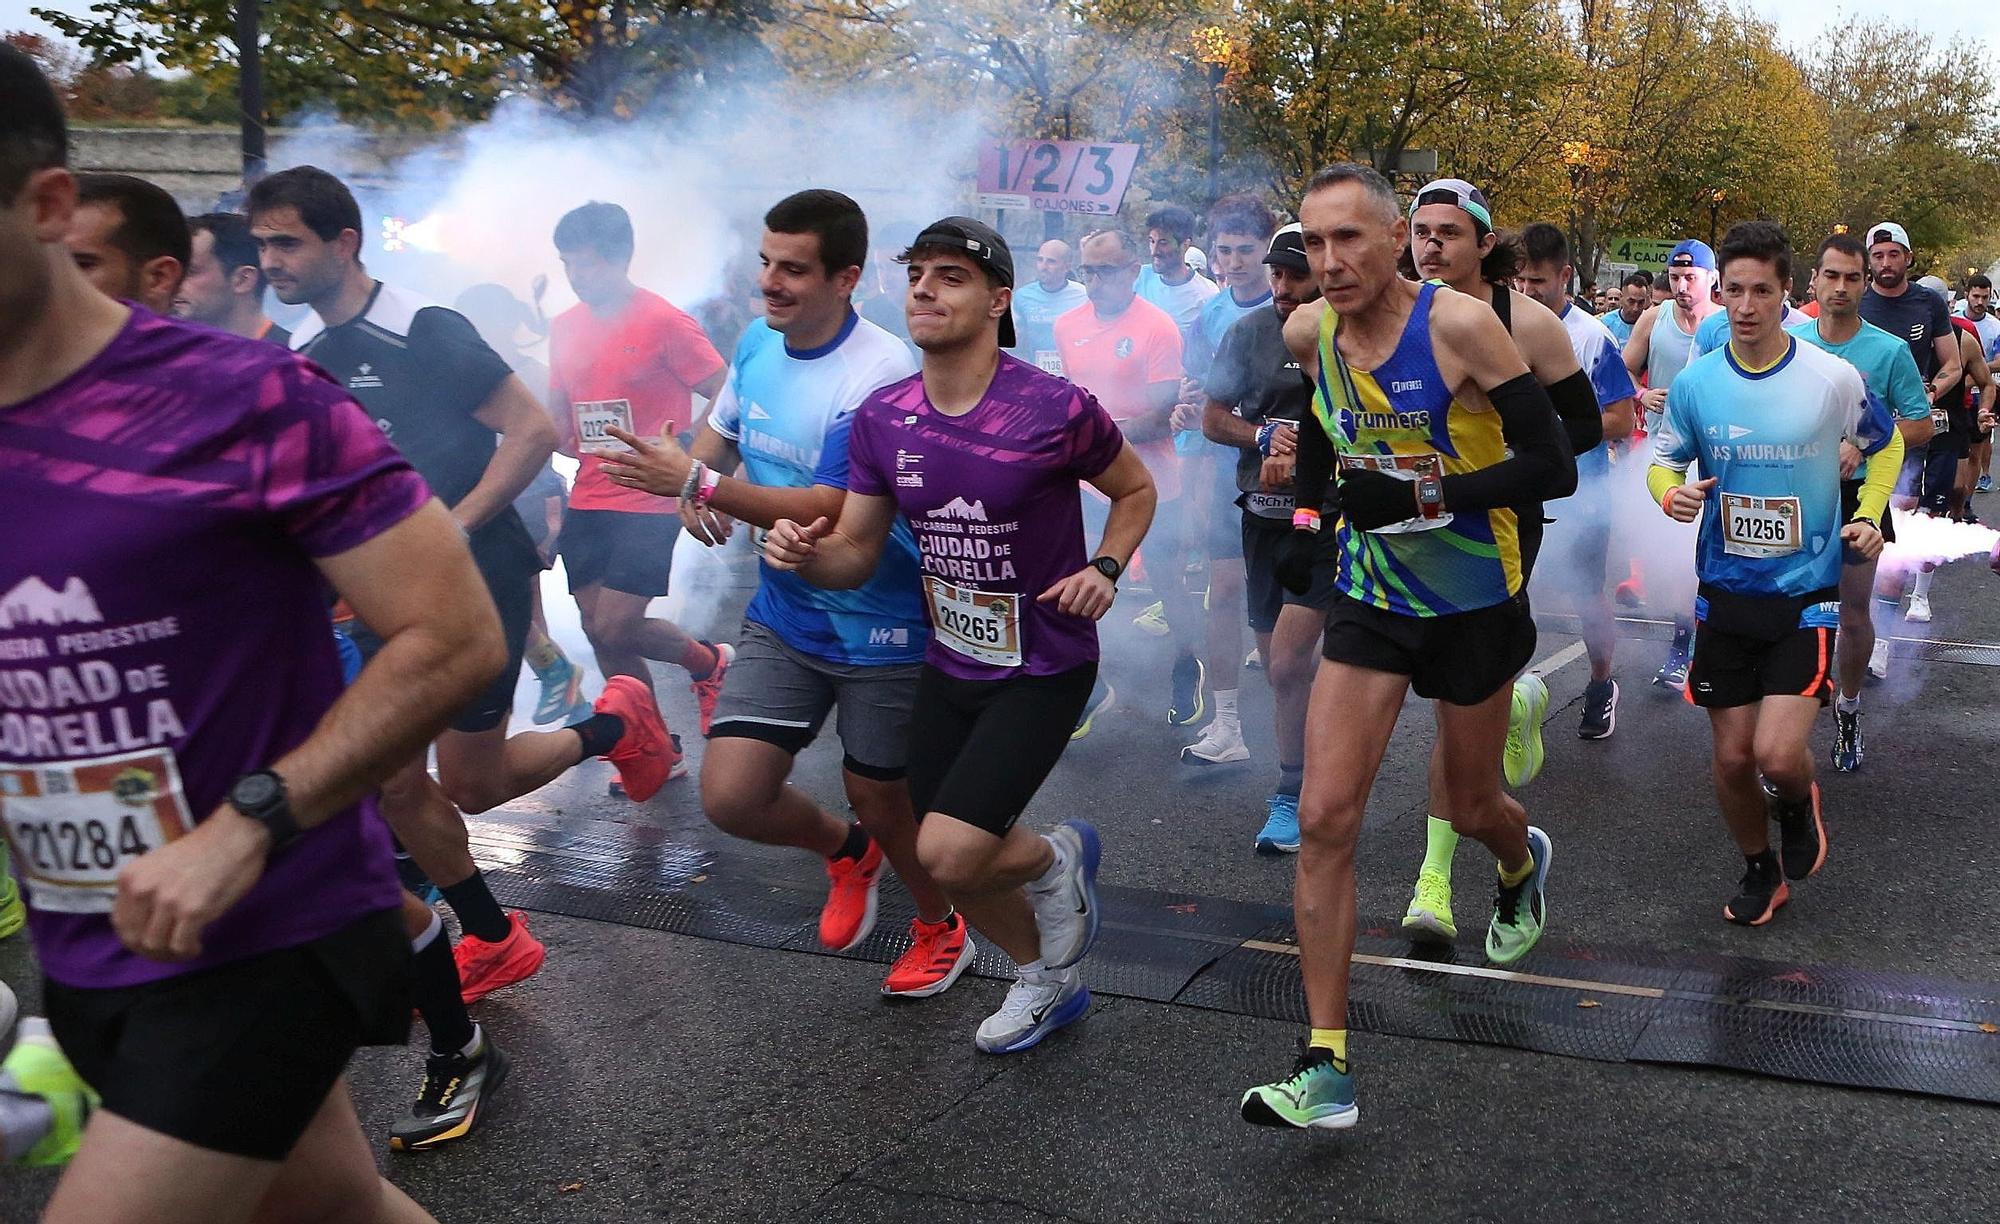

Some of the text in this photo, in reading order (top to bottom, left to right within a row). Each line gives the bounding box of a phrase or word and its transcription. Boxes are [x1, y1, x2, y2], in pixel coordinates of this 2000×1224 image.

[994, 143, 1114, 196] 1/2/3
[1034, 197, 1094, 212] CAJONES
[1618, 242, 1669, 263] 4 CAJÓ
[1354, 410, 1430, 430] runners
[1736, 441, 1821, 460] MURALLAS
[922, 522, 964, 533] CARRERA
[968, 521, 1020, 535] PEDESTRE
[1735, 516, 1786, 541] 21256
[920, 535, 1011, 559] CIUDAD DE
[924, 555, 1017, 581] CORELLA
[941, 606, 999, 643] 21265
[125, 664, 170, 693] DE
[18, 815, 150, 870] 21284
